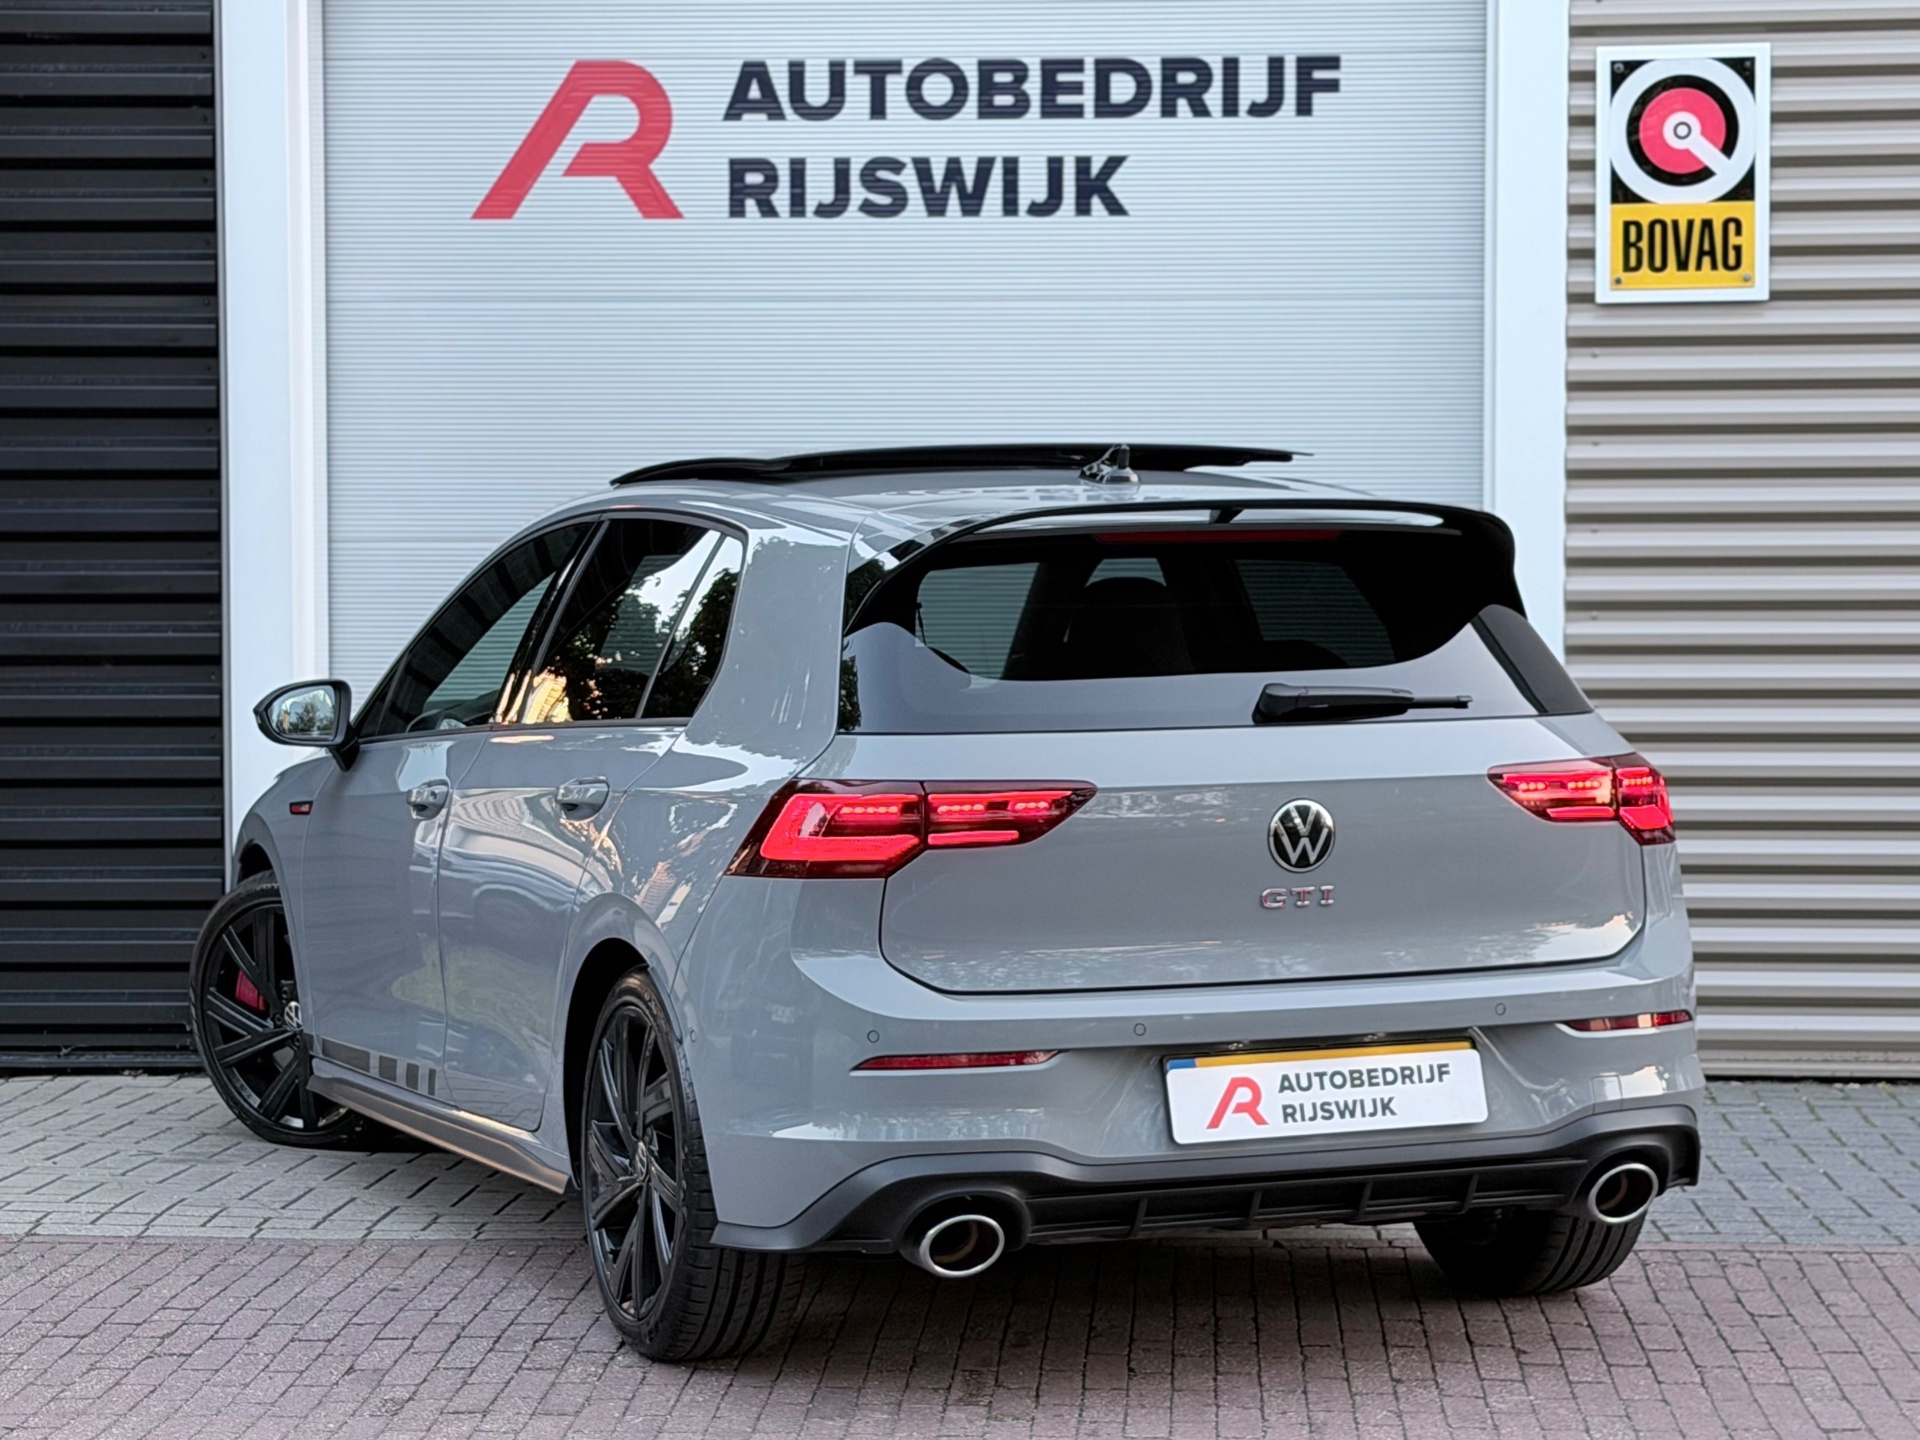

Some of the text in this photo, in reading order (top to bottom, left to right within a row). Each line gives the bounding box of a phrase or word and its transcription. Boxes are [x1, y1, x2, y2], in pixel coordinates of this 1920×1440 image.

[724, 55, 1340, 120] AUTOBEDRIJF
[729, 156, 1129, 218] RIJSWIJK
[1622, 217, 1743, 273] BOVAG
[1261, 885, 1335, 908] GTI
[1278, 1063, 1451, 1093] AUTOBEDRIJF
[1281, 1097, 1397, 1123] RIJSWIJK
